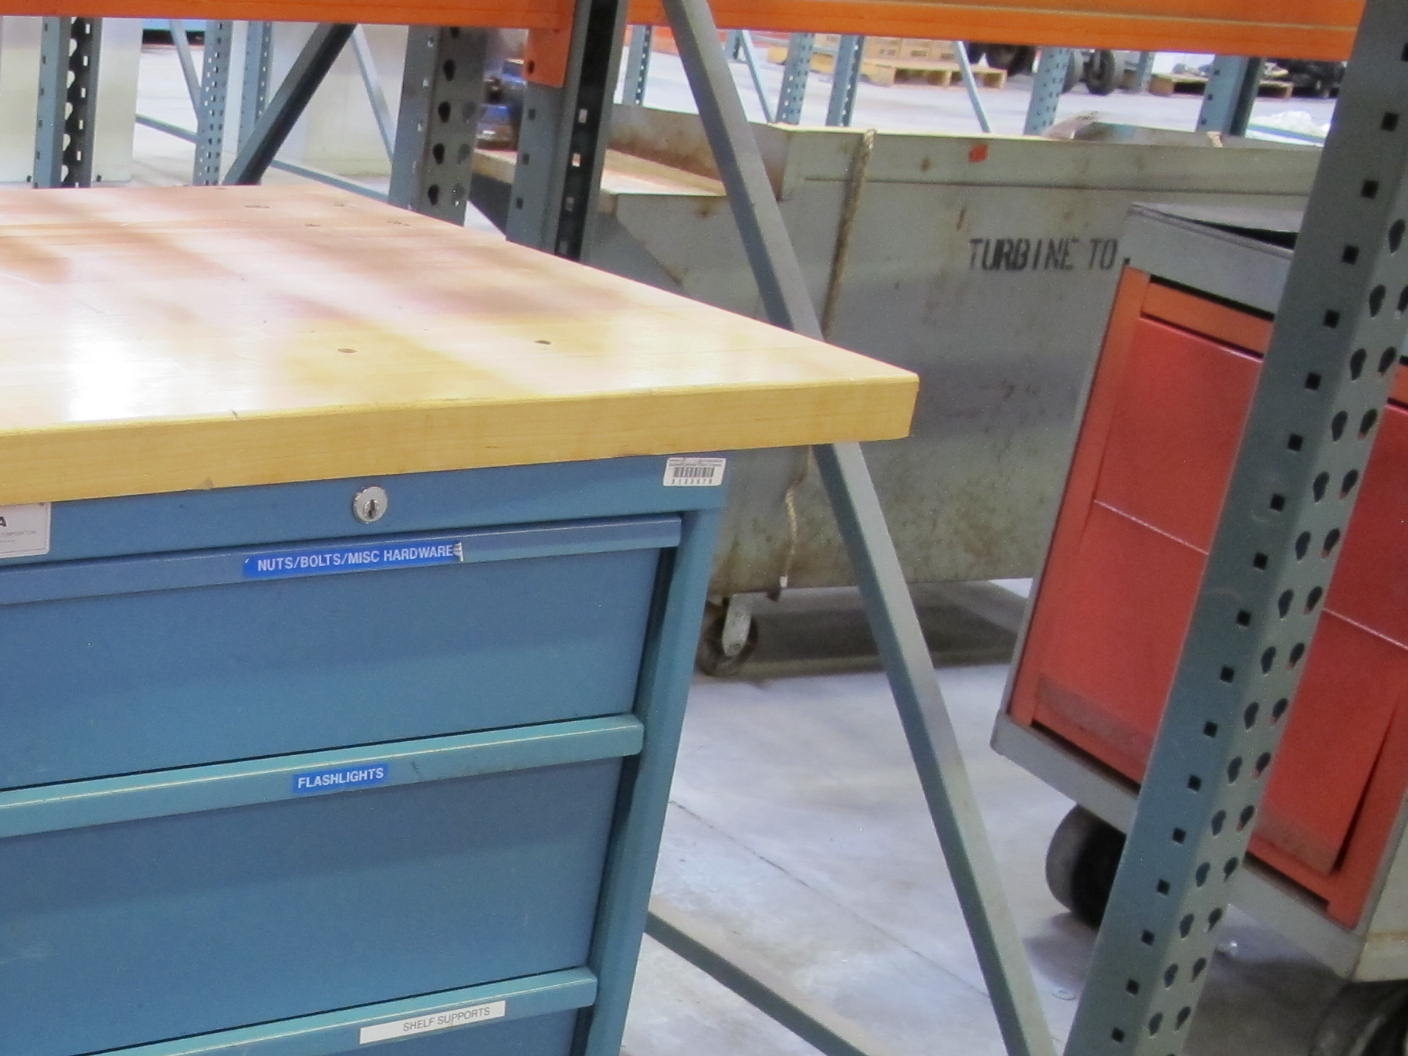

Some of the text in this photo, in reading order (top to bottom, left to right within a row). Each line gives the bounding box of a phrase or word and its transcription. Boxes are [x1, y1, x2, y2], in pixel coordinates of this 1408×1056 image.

[968, 237, 1119, 271] TURBINE TO
[257, 545, 454, 573] NUTS/BOLTS/MISC HARDWARE
[297, 767, 385, 789] FLASHLIGHTS
[402, 1006, 491, 1032] SHELF SUPPORTS
